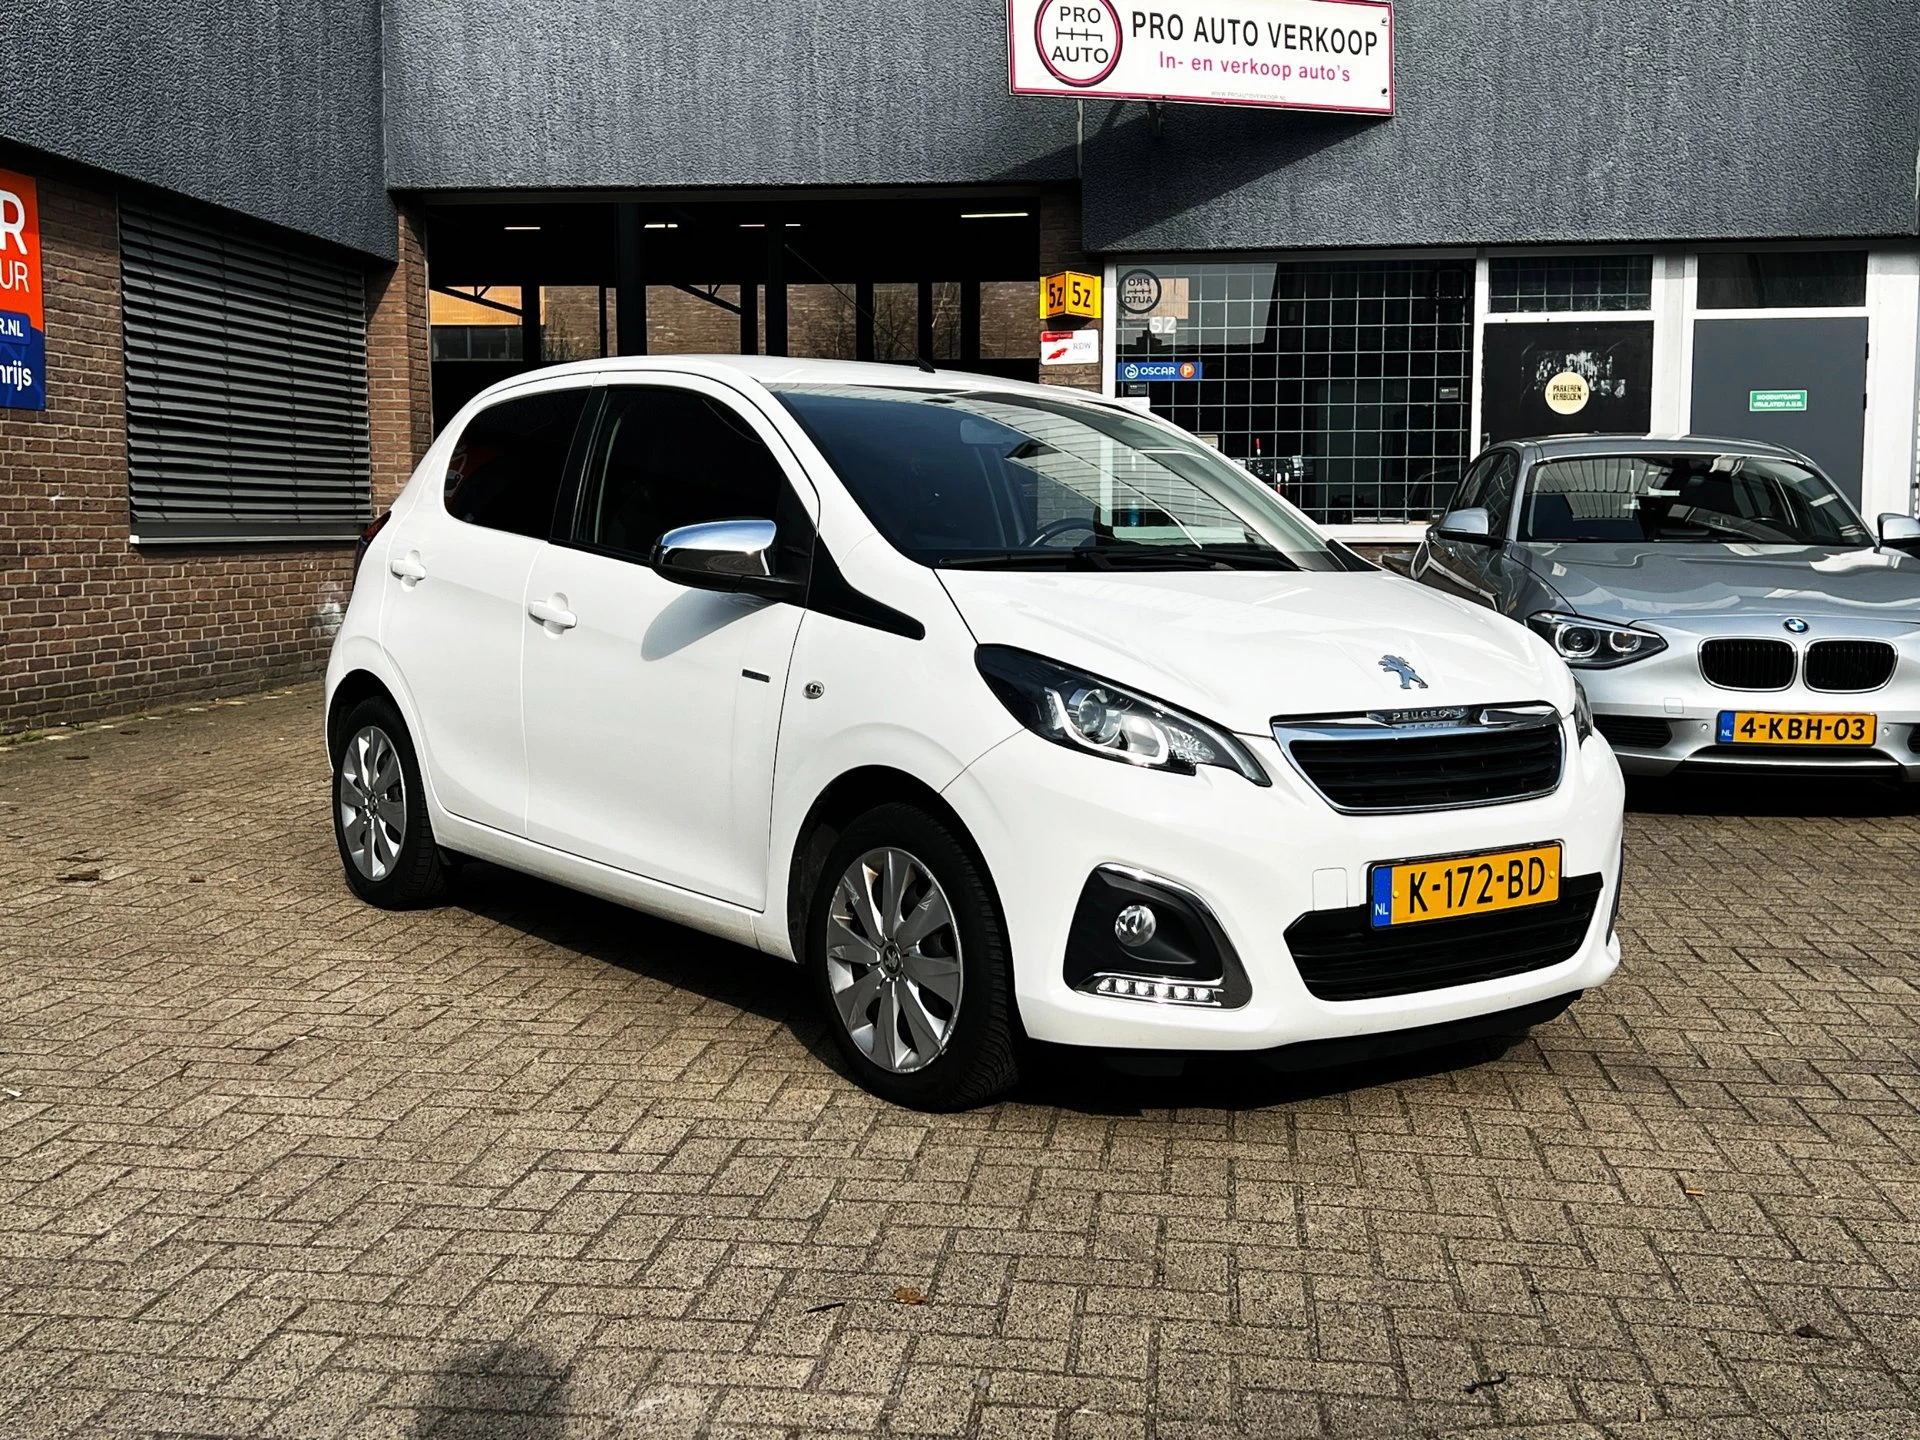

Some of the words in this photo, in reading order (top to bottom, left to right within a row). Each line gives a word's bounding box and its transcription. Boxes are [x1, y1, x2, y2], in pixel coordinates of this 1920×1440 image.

[1060, 6, 1101, 24] PRO
[1132, 11, 1184, 41] PRO
[1194, 16, 1259, 48] AUTO
[1267, 21, 1378, 56] VERKOOP
[1051, 46, 1109, 63] AUTO
[1159, 51, 1184, 70] In-
[1191, 58, 1213, 72] en
[1221, 60, 1292, 81] verkoop
[1299, 64, 1351, 83] auto's
[1140, 366, 1176, 376] OSCAR
[1184, 365, 1192, 377] P
[1552, 384, 1582, 393] PARKEREN
[1552, 393, 1582, 401] VERBODEN
[1720, 729, 1733, 738] NL
[1740, 717, 1866, 741] 4-KBH-03
[1375, 902, 1389, 917] NL
[1409, 855, 1546, 914] K-172-BD
